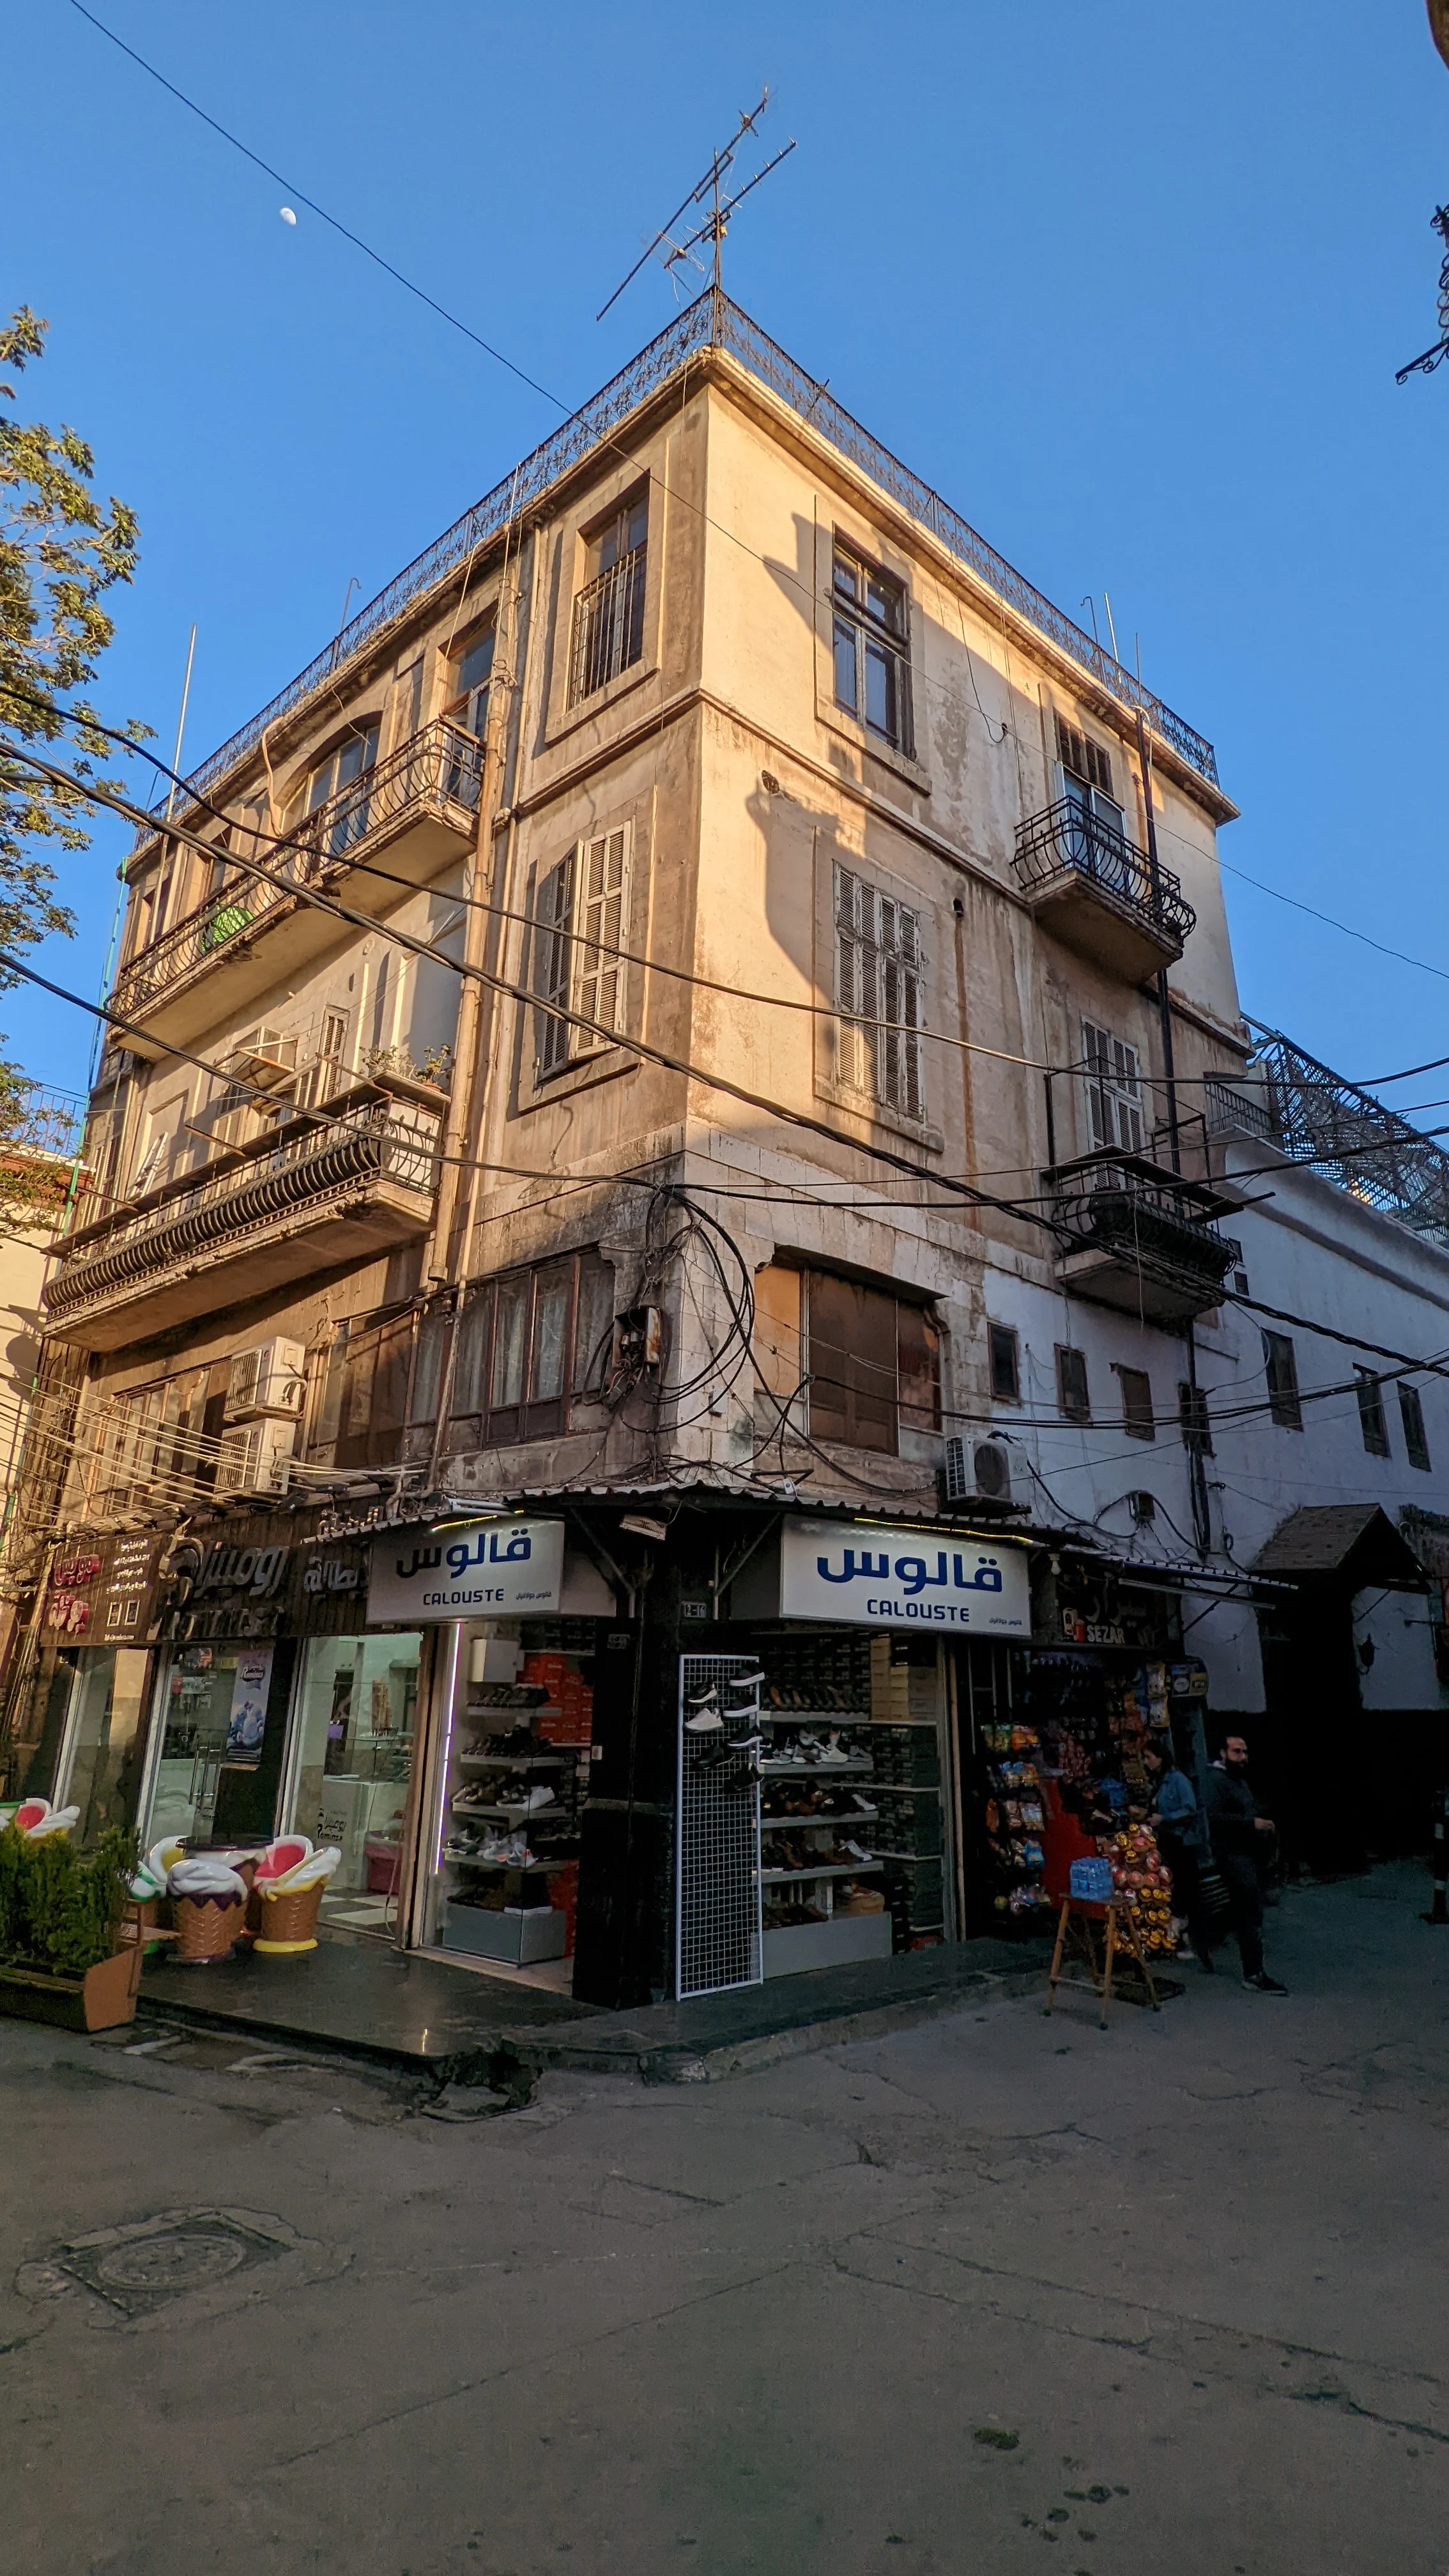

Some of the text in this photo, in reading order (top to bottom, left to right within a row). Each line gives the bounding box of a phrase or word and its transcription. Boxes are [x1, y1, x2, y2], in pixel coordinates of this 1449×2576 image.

[396, 1528, 532, 1579] قالوس
[816, 1548, 1003, 1595] قالوس
[423, 1588, 505, 1606] CALOUSTE
[867, 1599, 970, 1622] CALOUSTE
[1086, 1624, 1126, 1644] SEZAR
